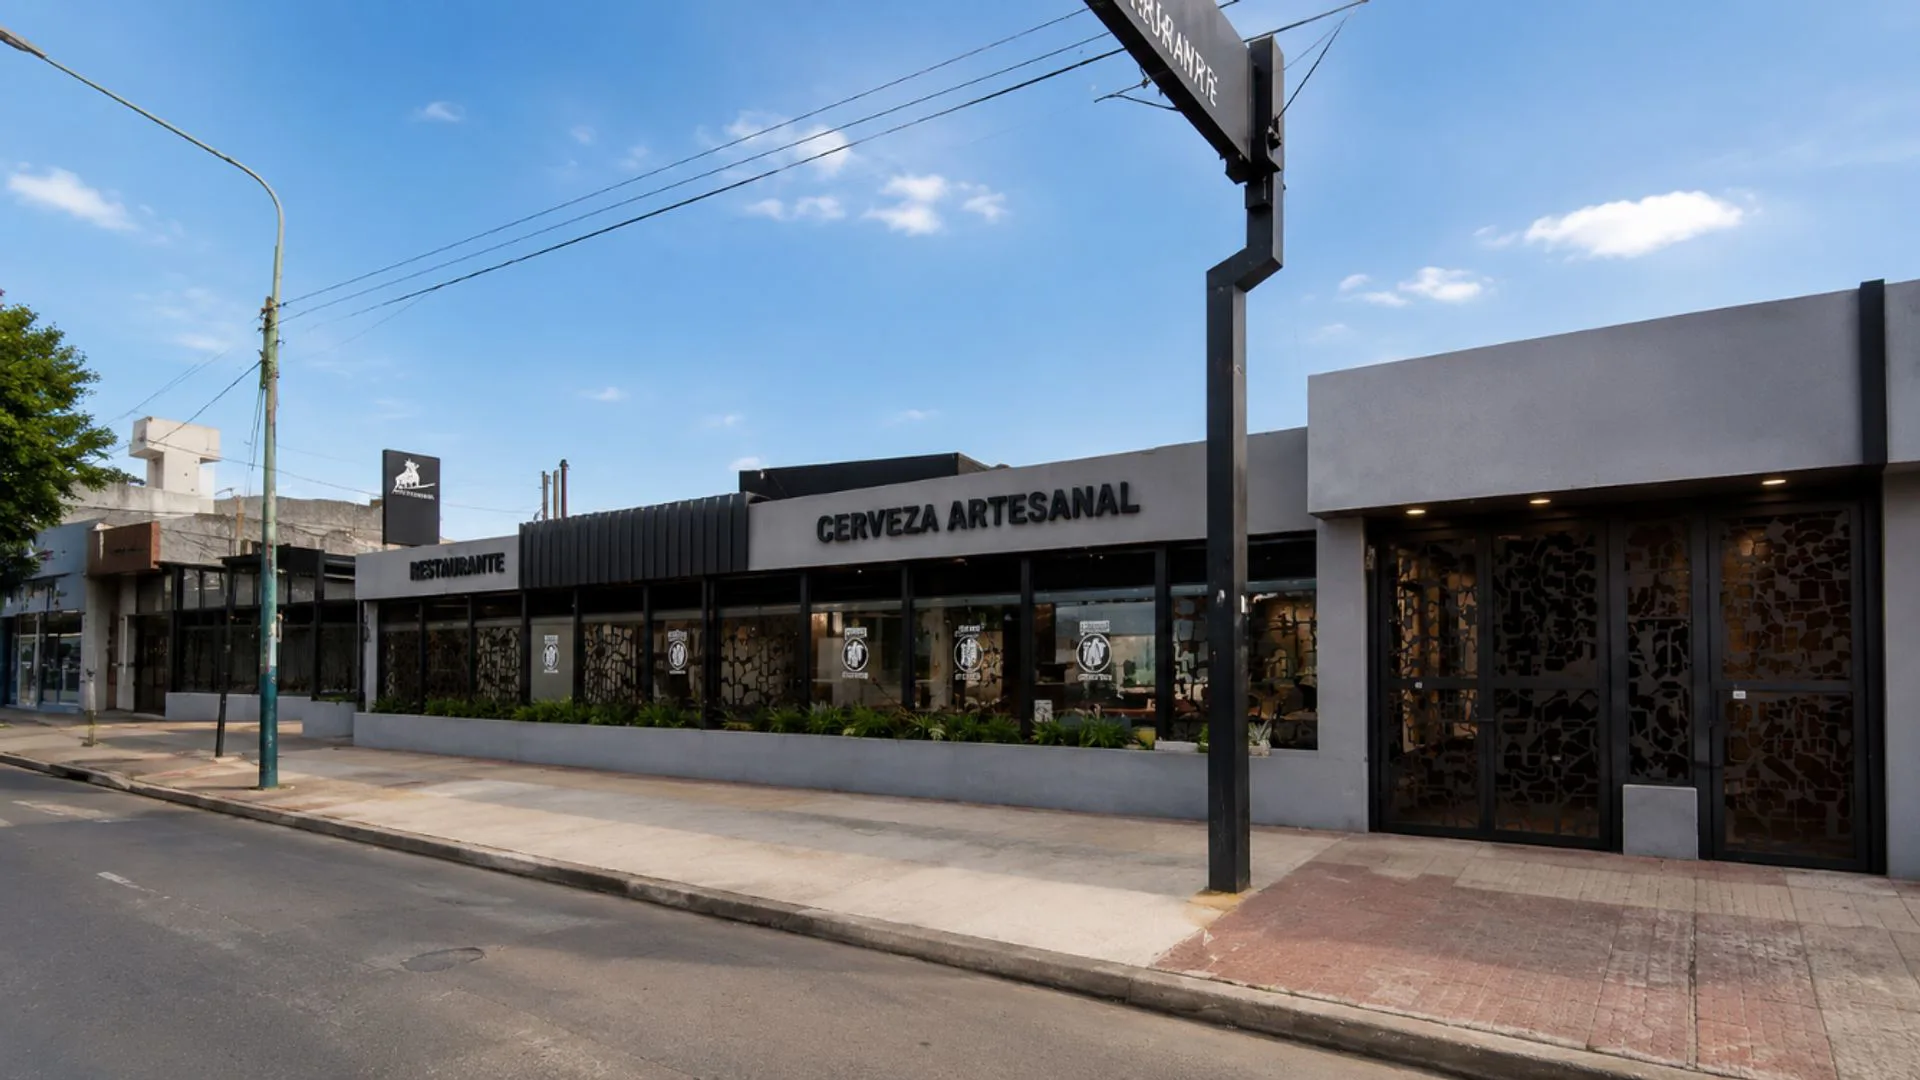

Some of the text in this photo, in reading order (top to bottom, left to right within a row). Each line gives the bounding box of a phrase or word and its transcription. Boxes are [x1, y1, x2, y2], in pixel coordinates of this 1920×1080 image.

[817, 481, 1140, 544] CERVEZA ARTESANAL
[410, 552, 505, 580] RESTAURANTE
